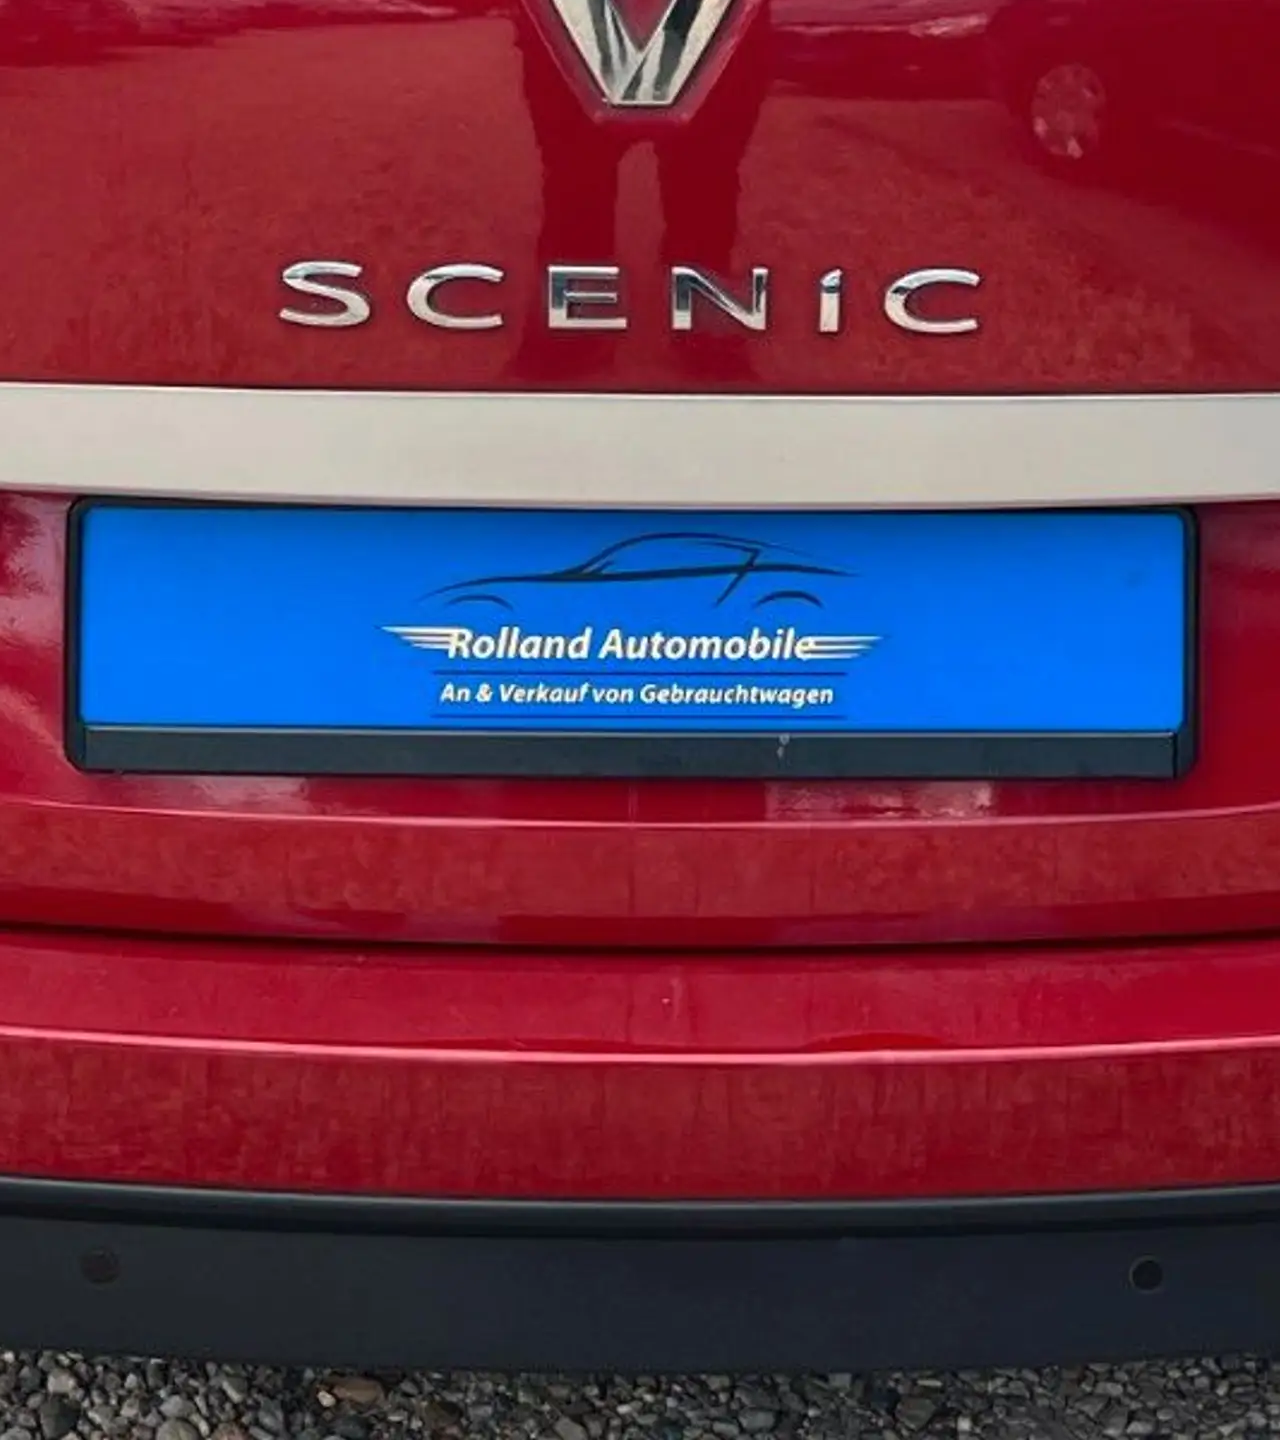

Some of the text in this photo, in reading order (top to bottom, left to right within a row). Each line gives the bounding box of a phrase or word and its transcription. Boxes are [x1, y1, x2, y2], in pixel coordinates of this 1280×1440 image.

[447, 626, 816, 660] Rolland Automobile
[440, 682, 834, 709] An & Verkauf von Gebrauchtwagen
